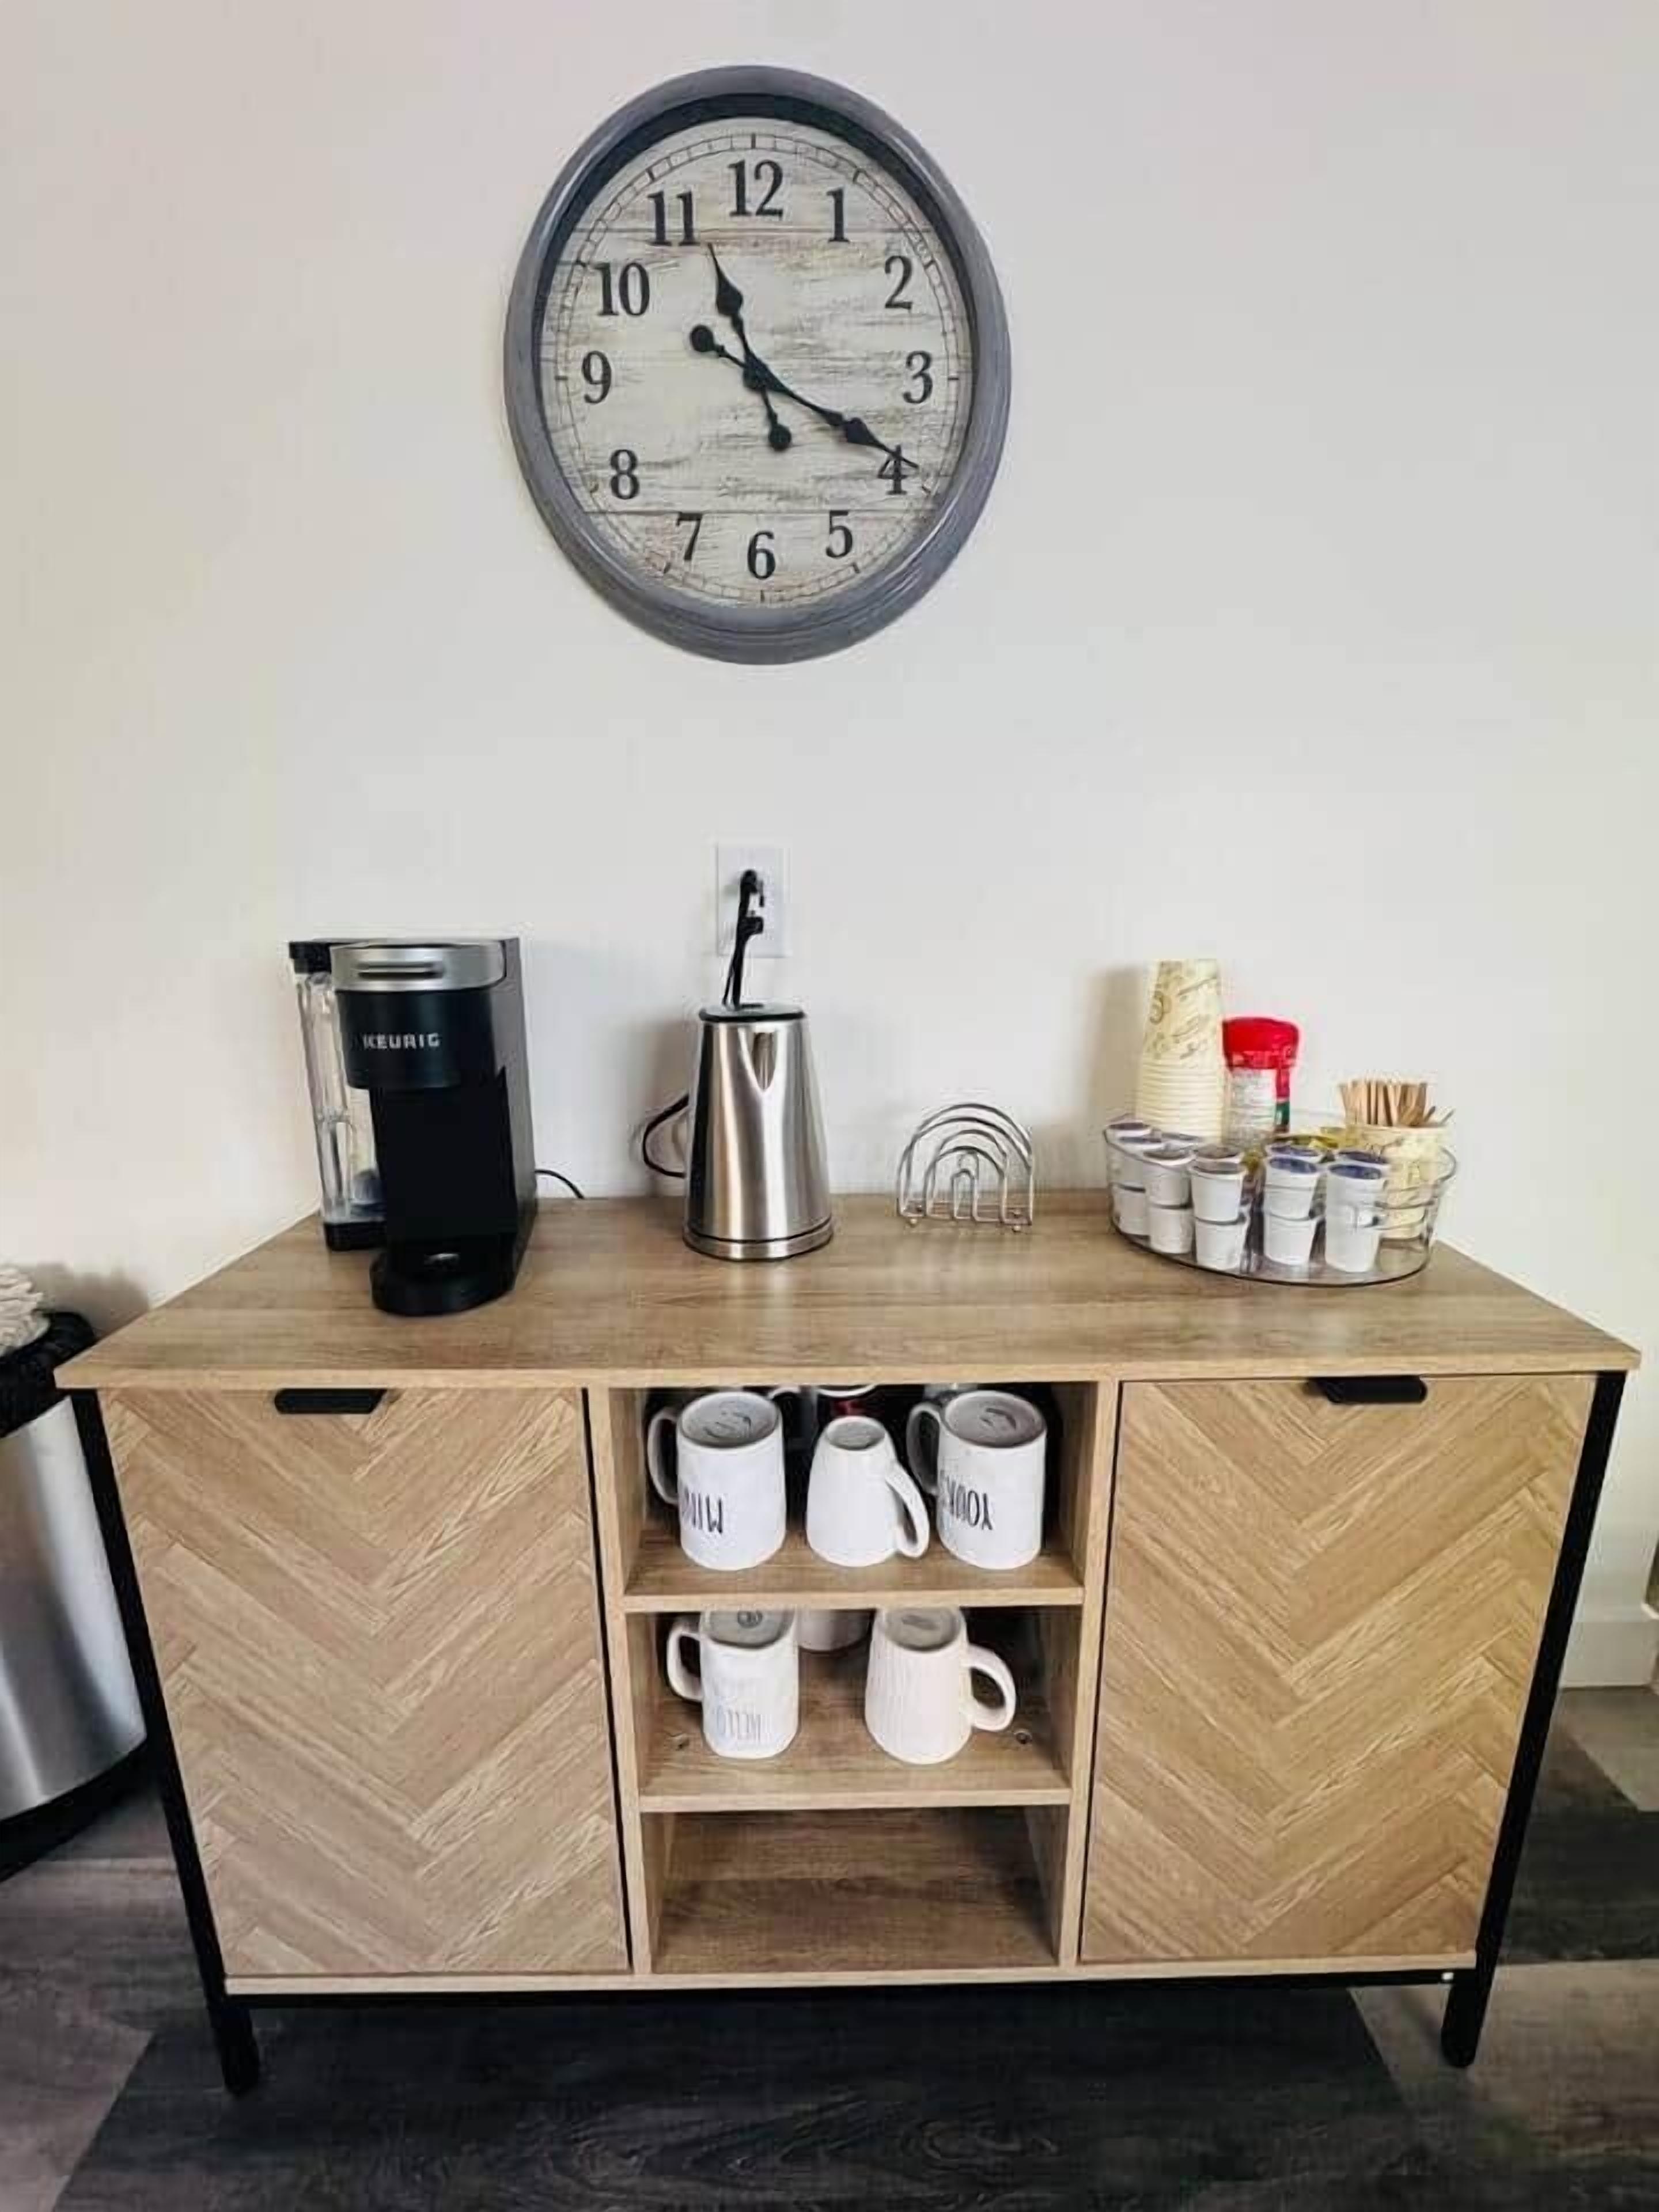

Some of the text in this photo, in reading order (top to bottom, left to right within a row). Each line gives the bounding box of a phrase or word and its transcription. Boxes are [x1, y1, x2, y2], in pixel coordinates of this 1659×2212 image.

[728, 160, 783, 219] 12
[826, 188, 850, 243] 1
[646, 190, 701, 247] 11
[592, 262, 650, 317] 10
[884, 255, 913, 311] 2
[581, 350, 612, 404] 9
[902, 350, 933, 404] 3
[609, 449, 641, 501] 8
[877, 444, 908, 495] 4
[675, 510, 704, 562] 7
[747, 531, 777, 581] 6
[825, 509, 854, 559] 5
[363, 1032, 440, 1049] KEURIG
